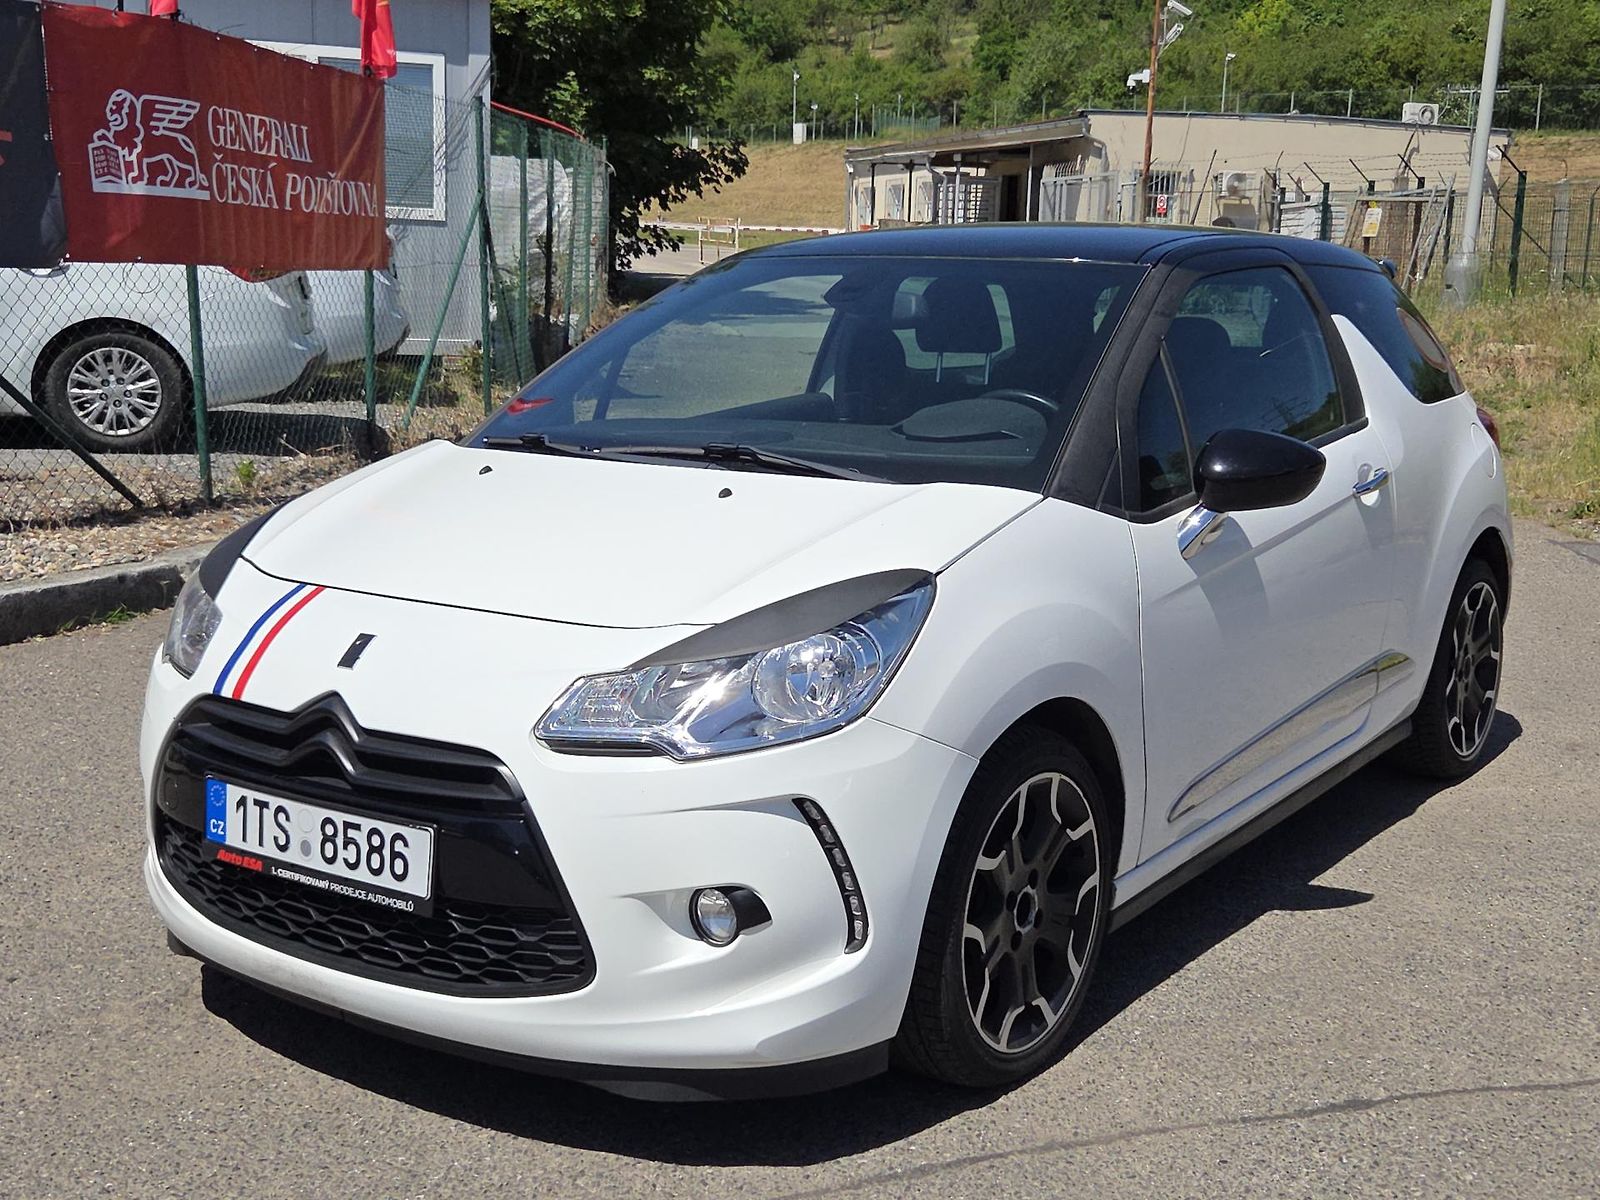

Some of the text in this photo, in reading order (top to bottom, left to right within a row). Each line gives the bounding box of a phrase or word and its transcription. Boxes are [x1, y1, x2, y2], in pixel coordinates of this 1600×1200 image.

[207, 105, 313, 163] GENERALI
[212, 152, 279, 210] ČESKÁ
[210, 818, 225, 835] CZ
[236, 794, 410, 882] 1TS 8586
[330, 882, 367, 900] PRODEJCE
[367, 892, 414, 912] AUTOMOBILŮ
